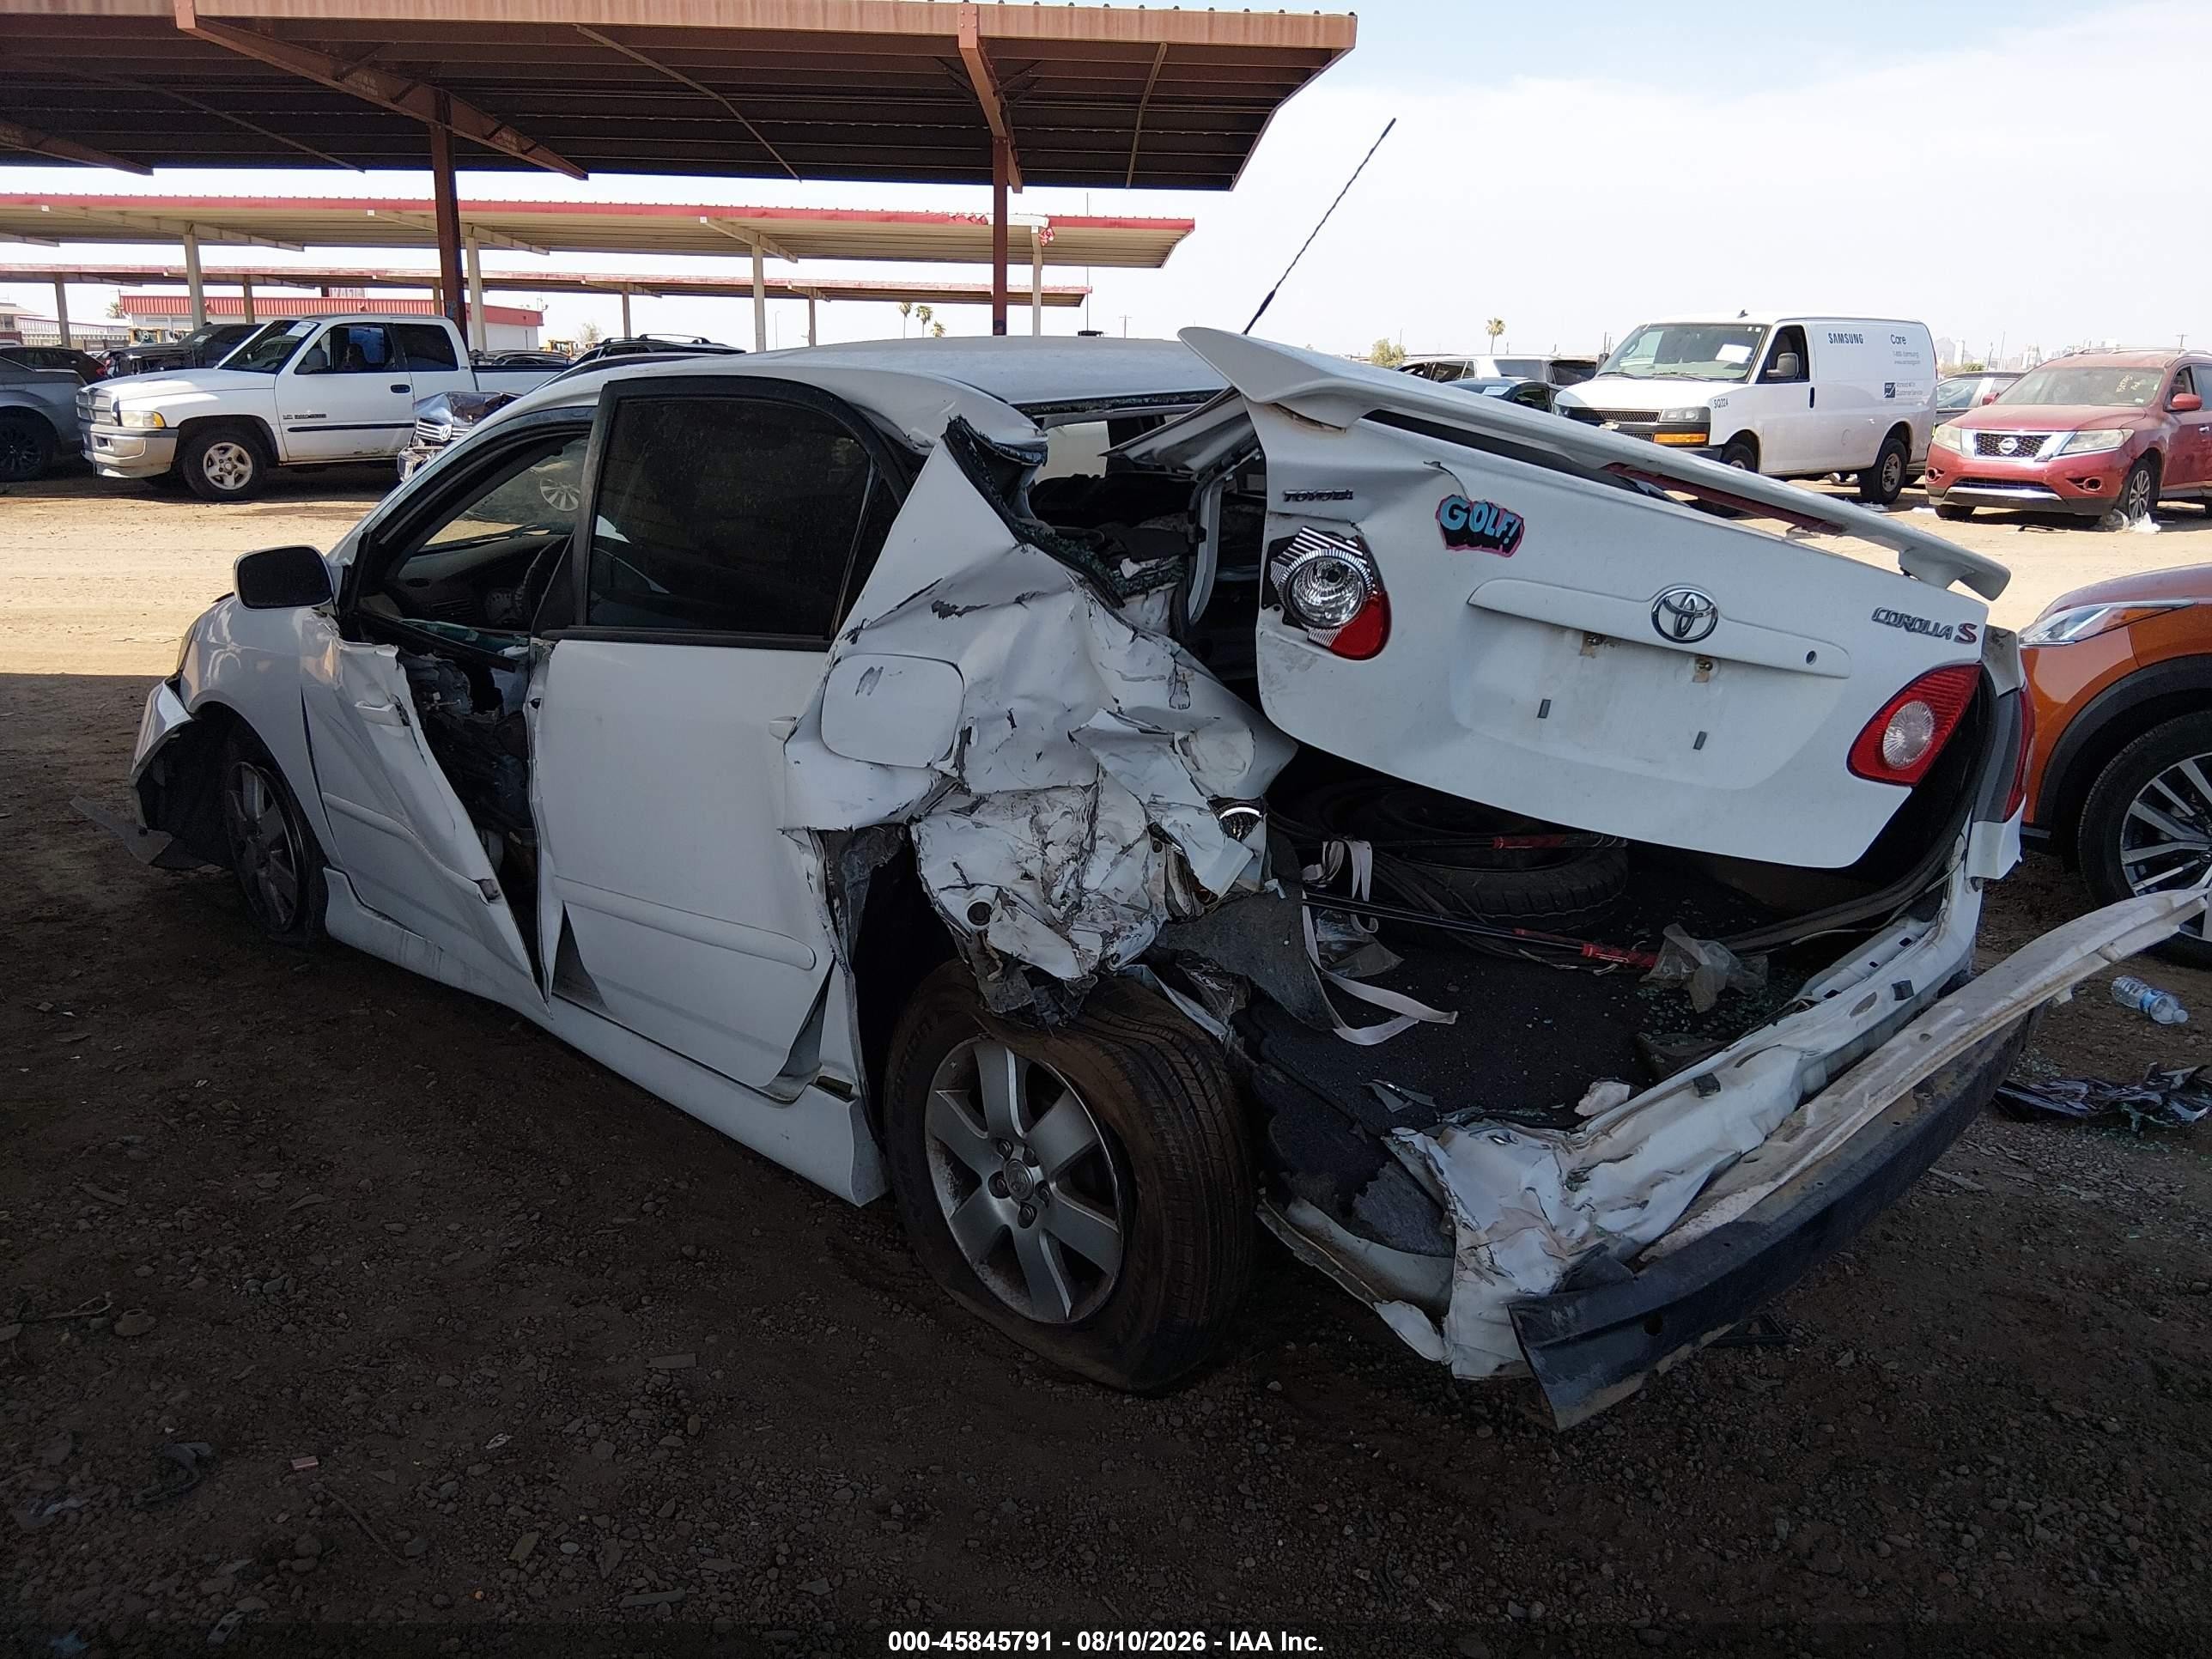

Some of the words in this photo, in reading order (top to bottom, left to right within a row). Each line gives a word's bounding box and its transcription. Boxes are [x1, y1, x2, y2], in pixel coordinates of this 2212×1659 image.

[1827, 332, 1864, 344] SAMSUNG
[1890, 333, 1907, 344] Care
[1283, 489, 1354, 503] TOYOTA
[1439, 495, 1522, 545] GOLF!
[1871, 606, 1954, 641] COROLLA
[1953, 623, 1978, 645] S
